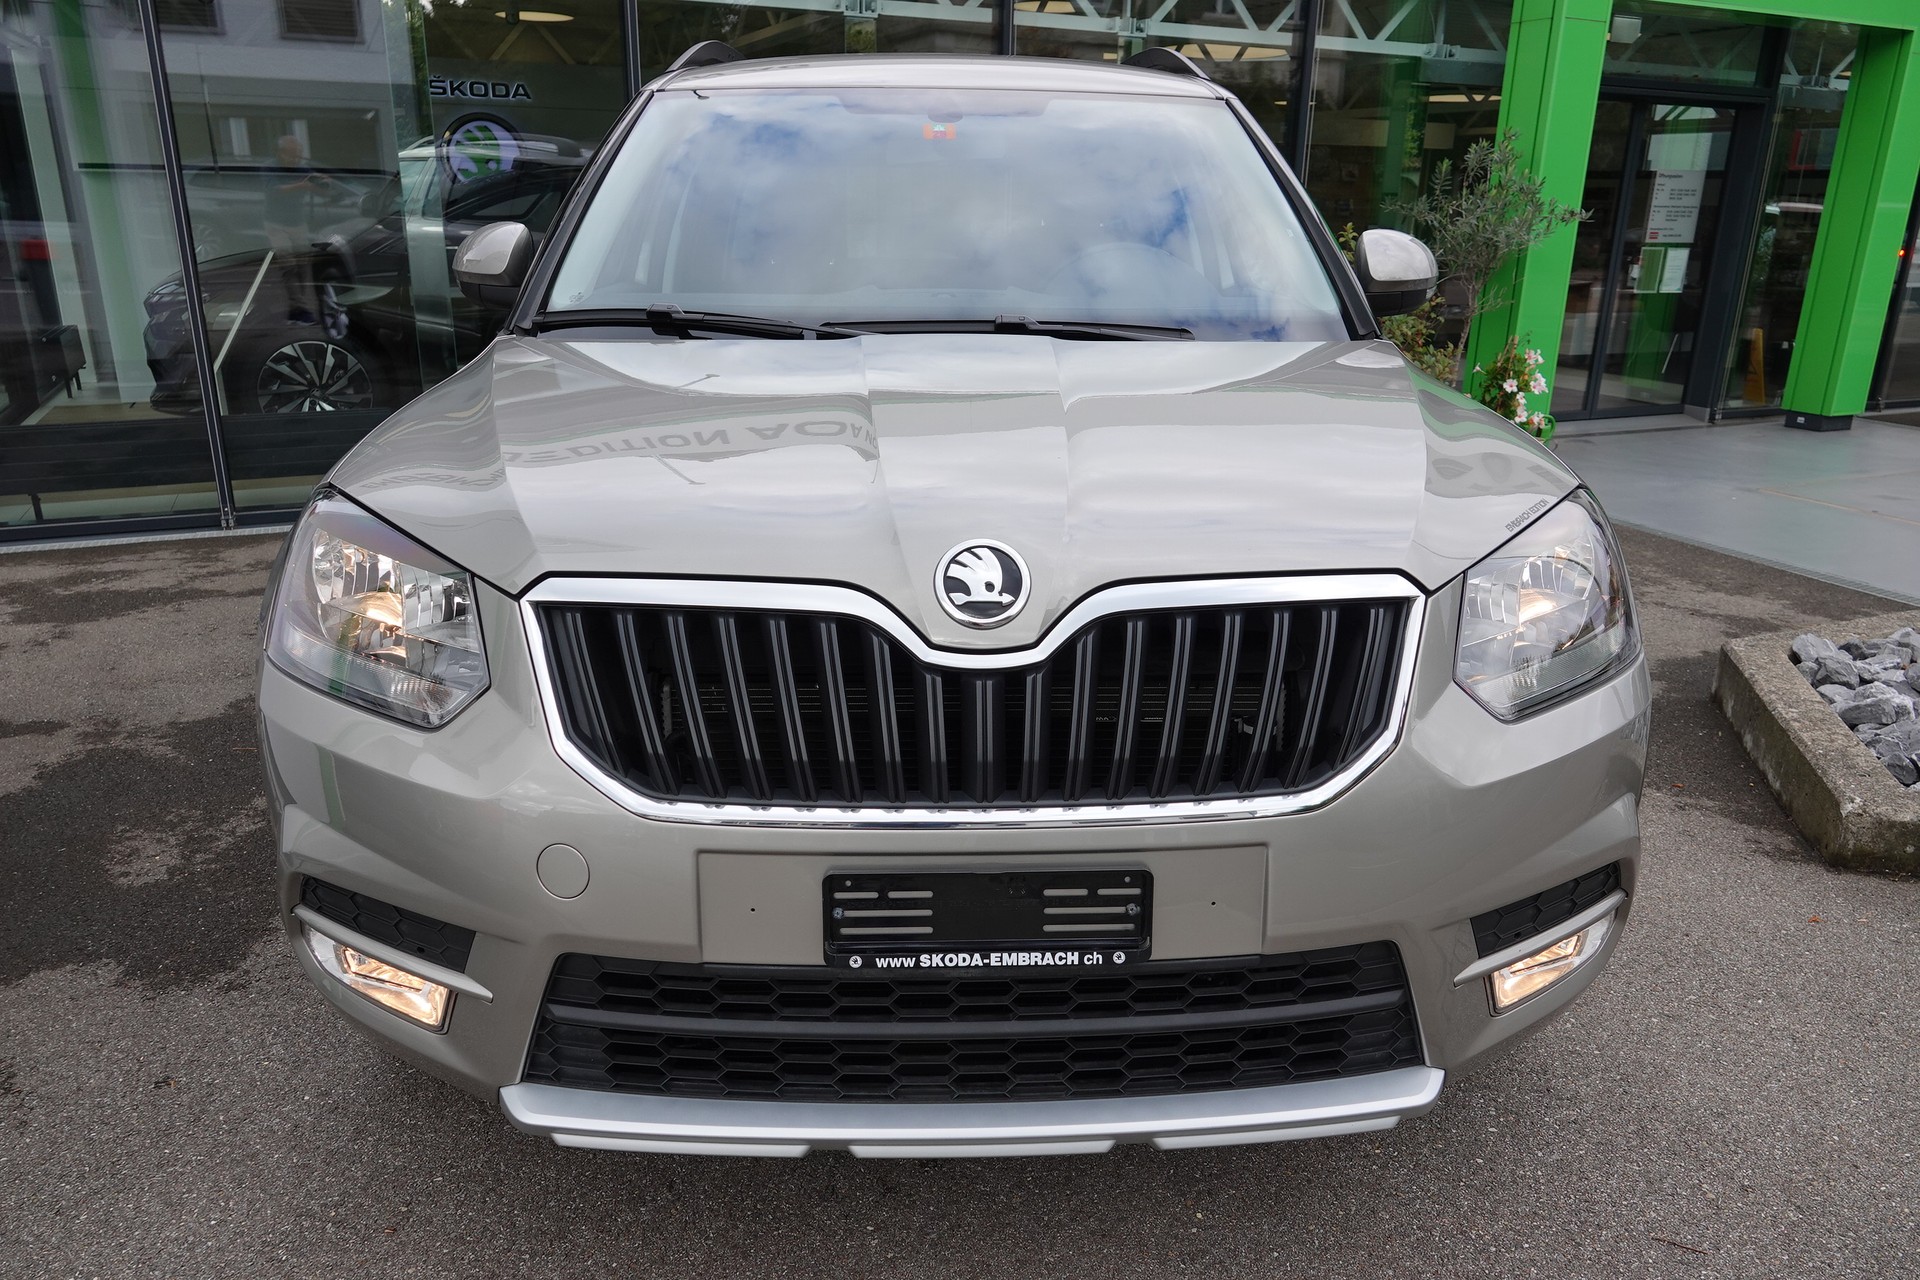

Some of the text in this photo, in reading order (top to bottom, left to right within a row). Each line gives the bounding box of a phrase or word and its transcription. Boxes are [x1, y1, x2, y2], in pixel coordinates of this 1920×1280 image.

[429, 75, 532, 100] ŠKODA
[875, 951, 1103, 968] www SKODA-EMBRACH ch
